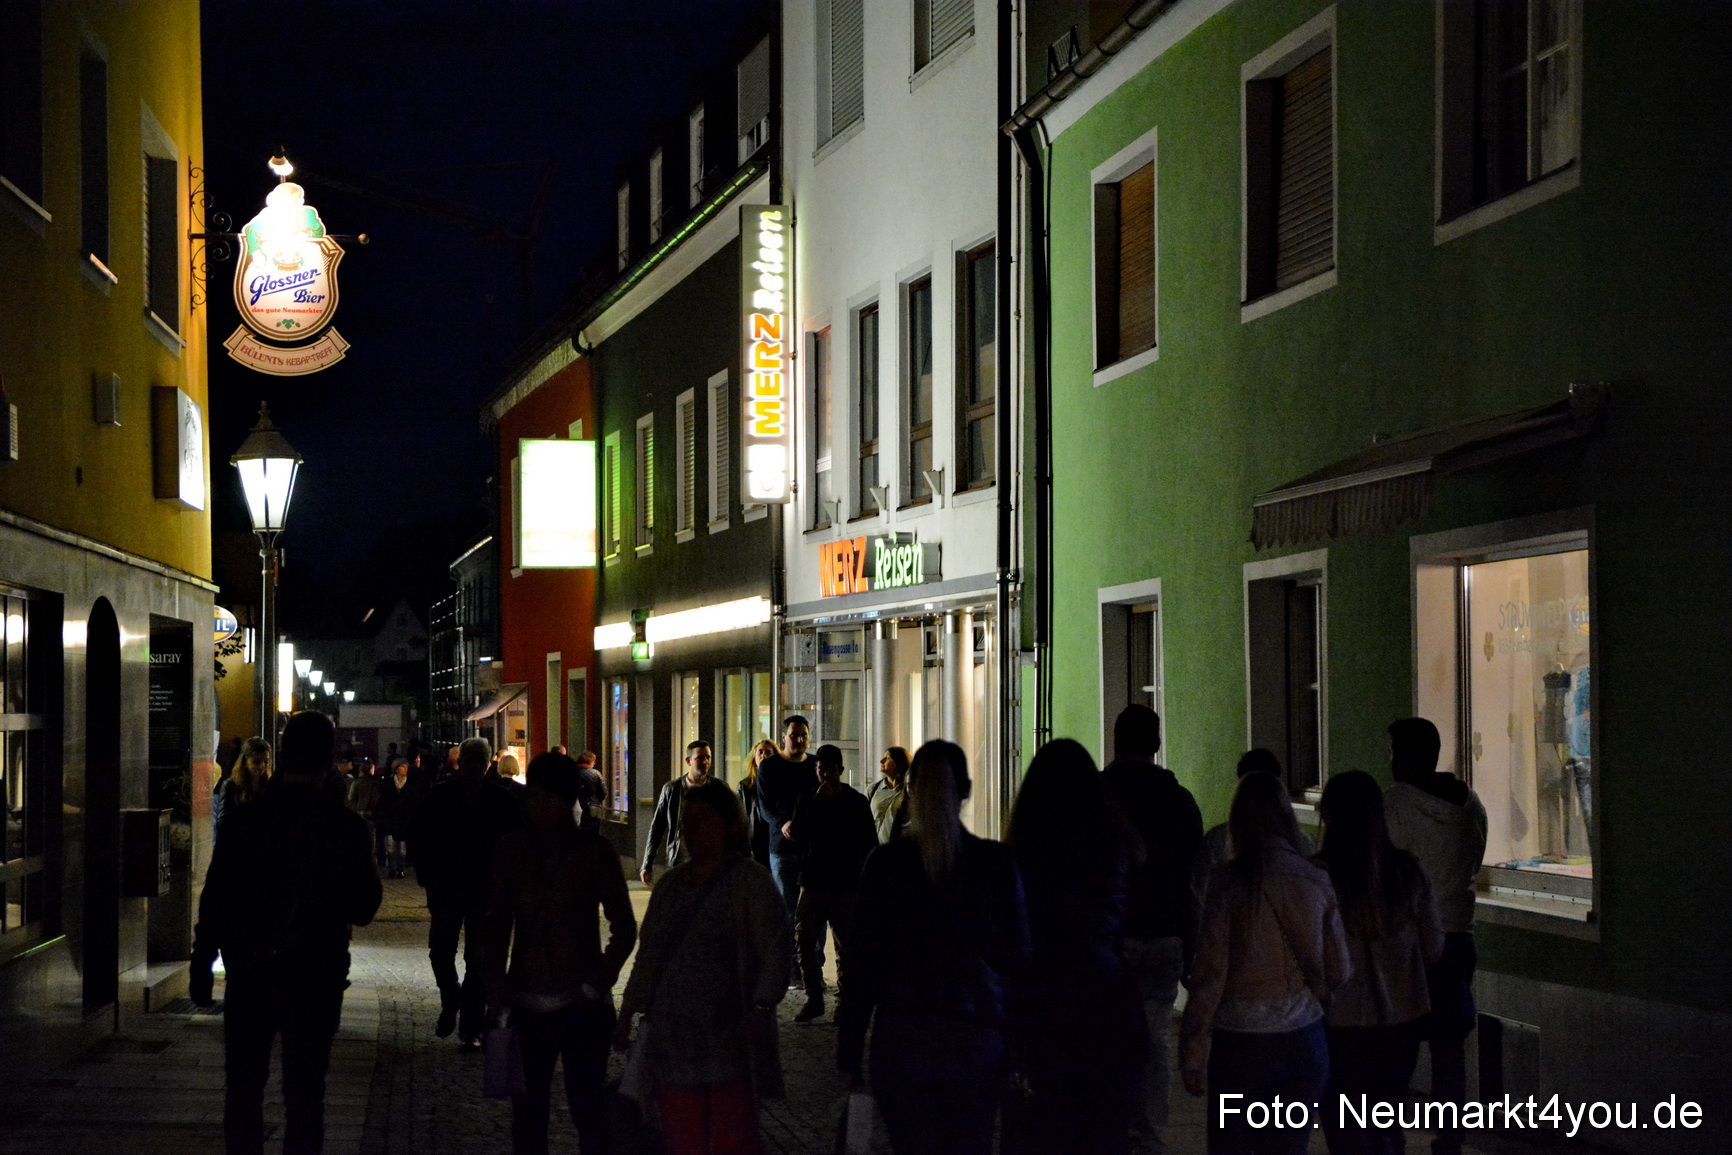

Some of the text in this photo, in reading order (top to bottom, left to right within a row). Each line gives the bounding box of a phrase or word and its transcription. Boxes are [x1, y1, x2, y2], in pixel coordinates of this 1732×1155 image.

[293, 288, 325, 303] Bier
[753, 209, 783, 435] MERZ Reisen
[819, 531, 923, 598] MERZ Reisen
